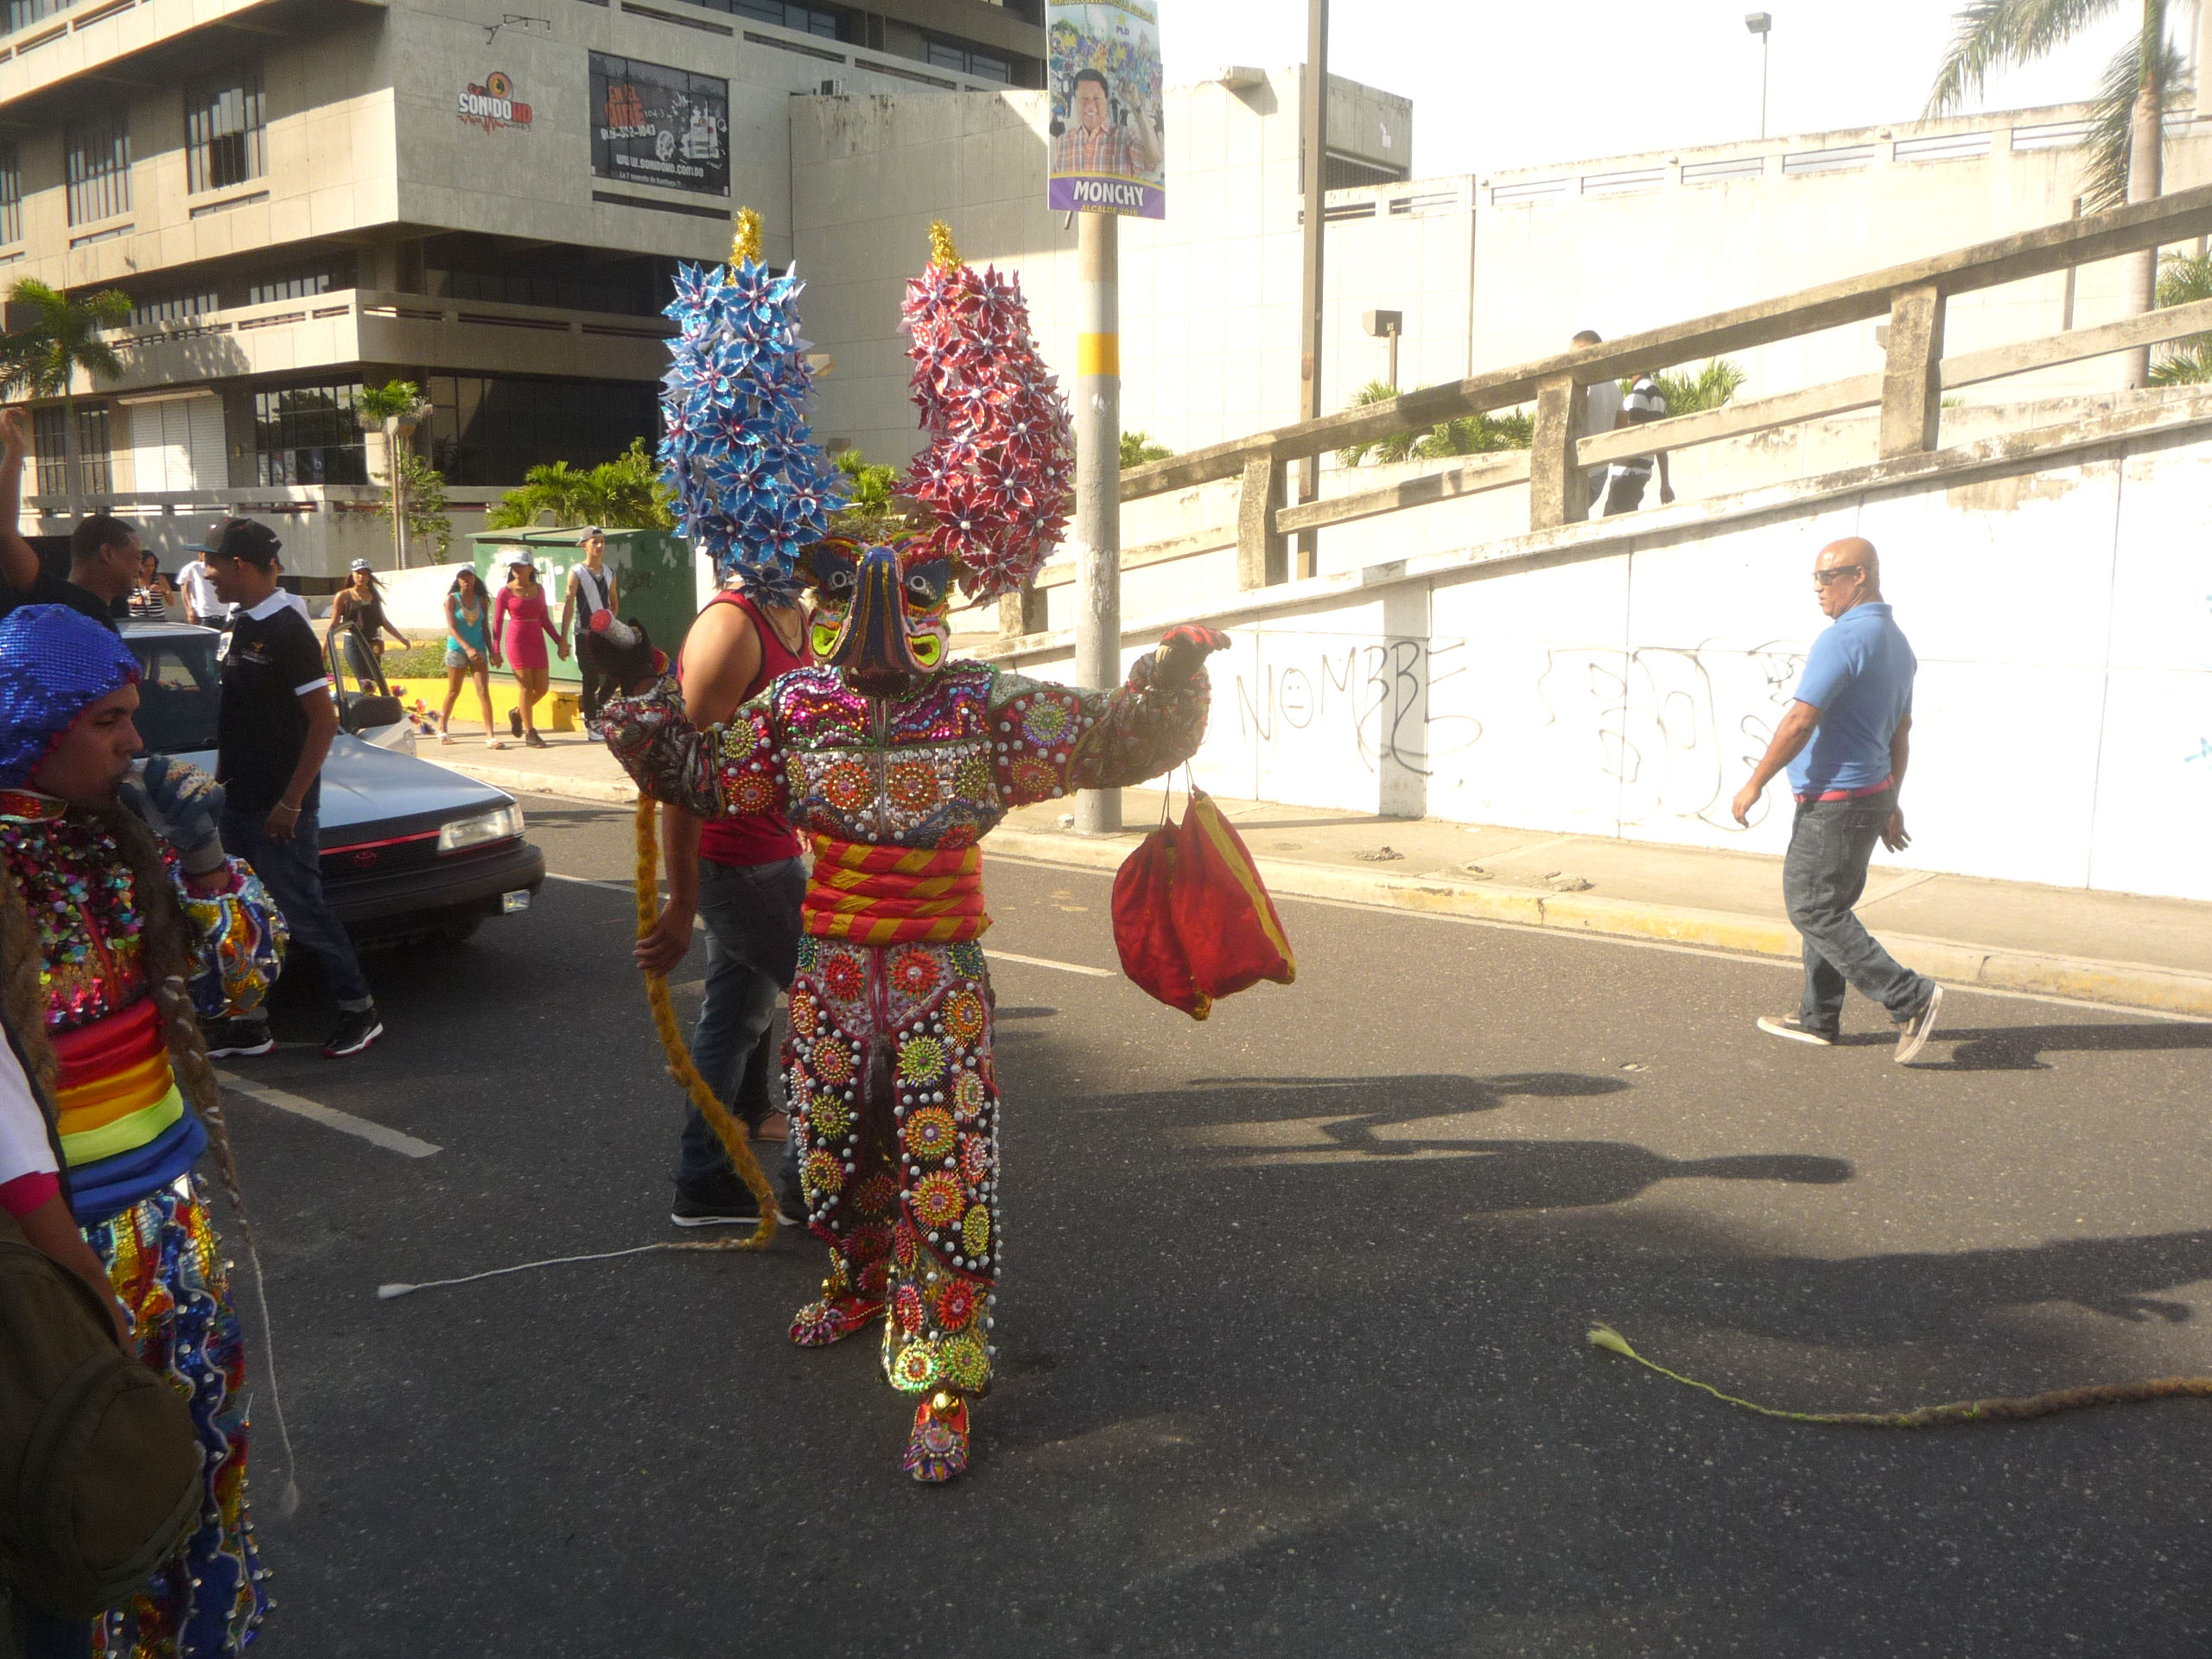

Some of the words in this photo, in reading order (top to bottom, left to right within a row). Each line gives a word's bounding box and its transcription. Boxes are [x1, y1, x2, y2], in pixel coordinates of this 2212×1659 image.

[1116, 26, 1130, 35] PLD
[1072, 180, 1145, 207] MONCHY
[1081, 204, 1118, 214] ALCALDE
